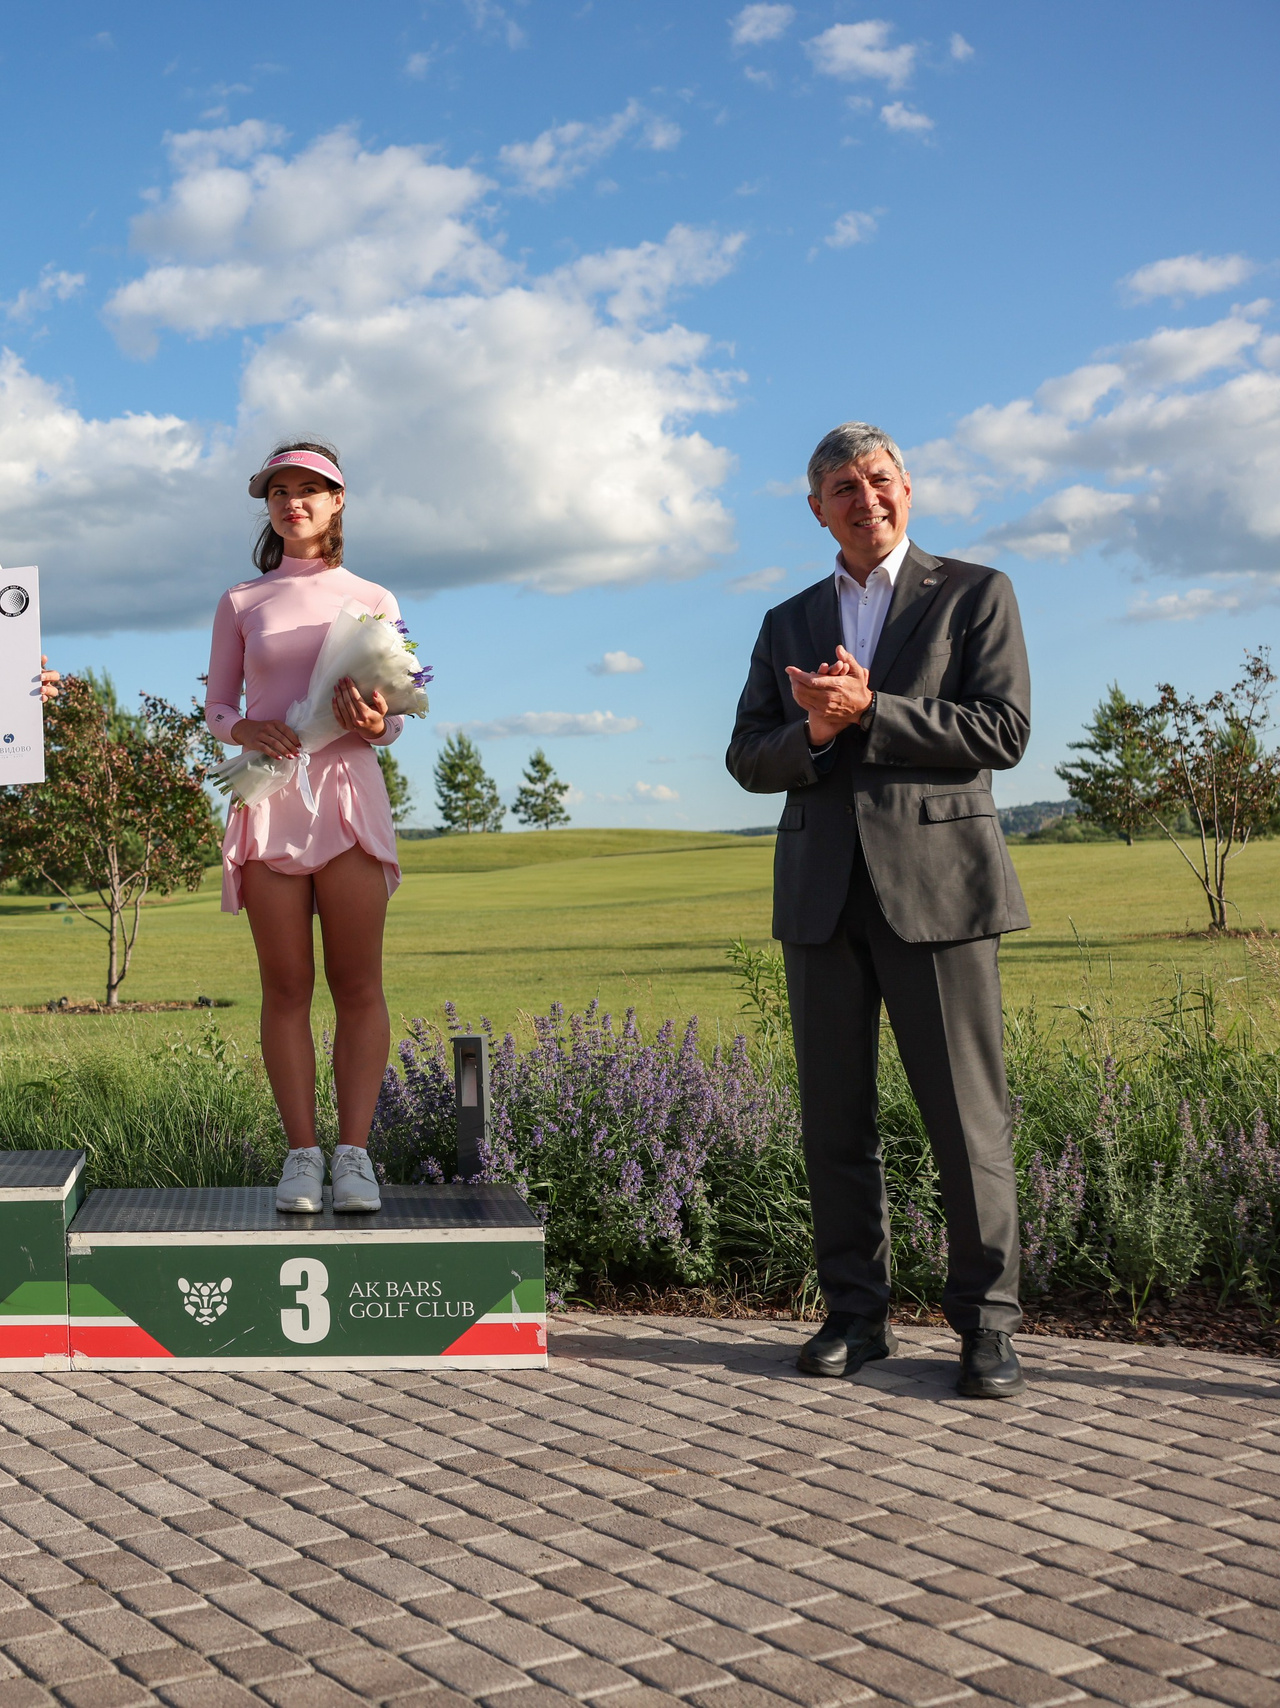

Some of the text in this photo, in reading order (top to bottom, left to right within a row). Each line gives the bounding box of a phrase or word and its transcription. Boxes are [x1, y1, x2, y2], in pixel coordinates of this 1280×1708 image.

[348, 1280, 442, 1298] AK BARS
[279, 1257, 331, 1344] 3
[349, 1301, 475, 1318] GOLF CLUB
